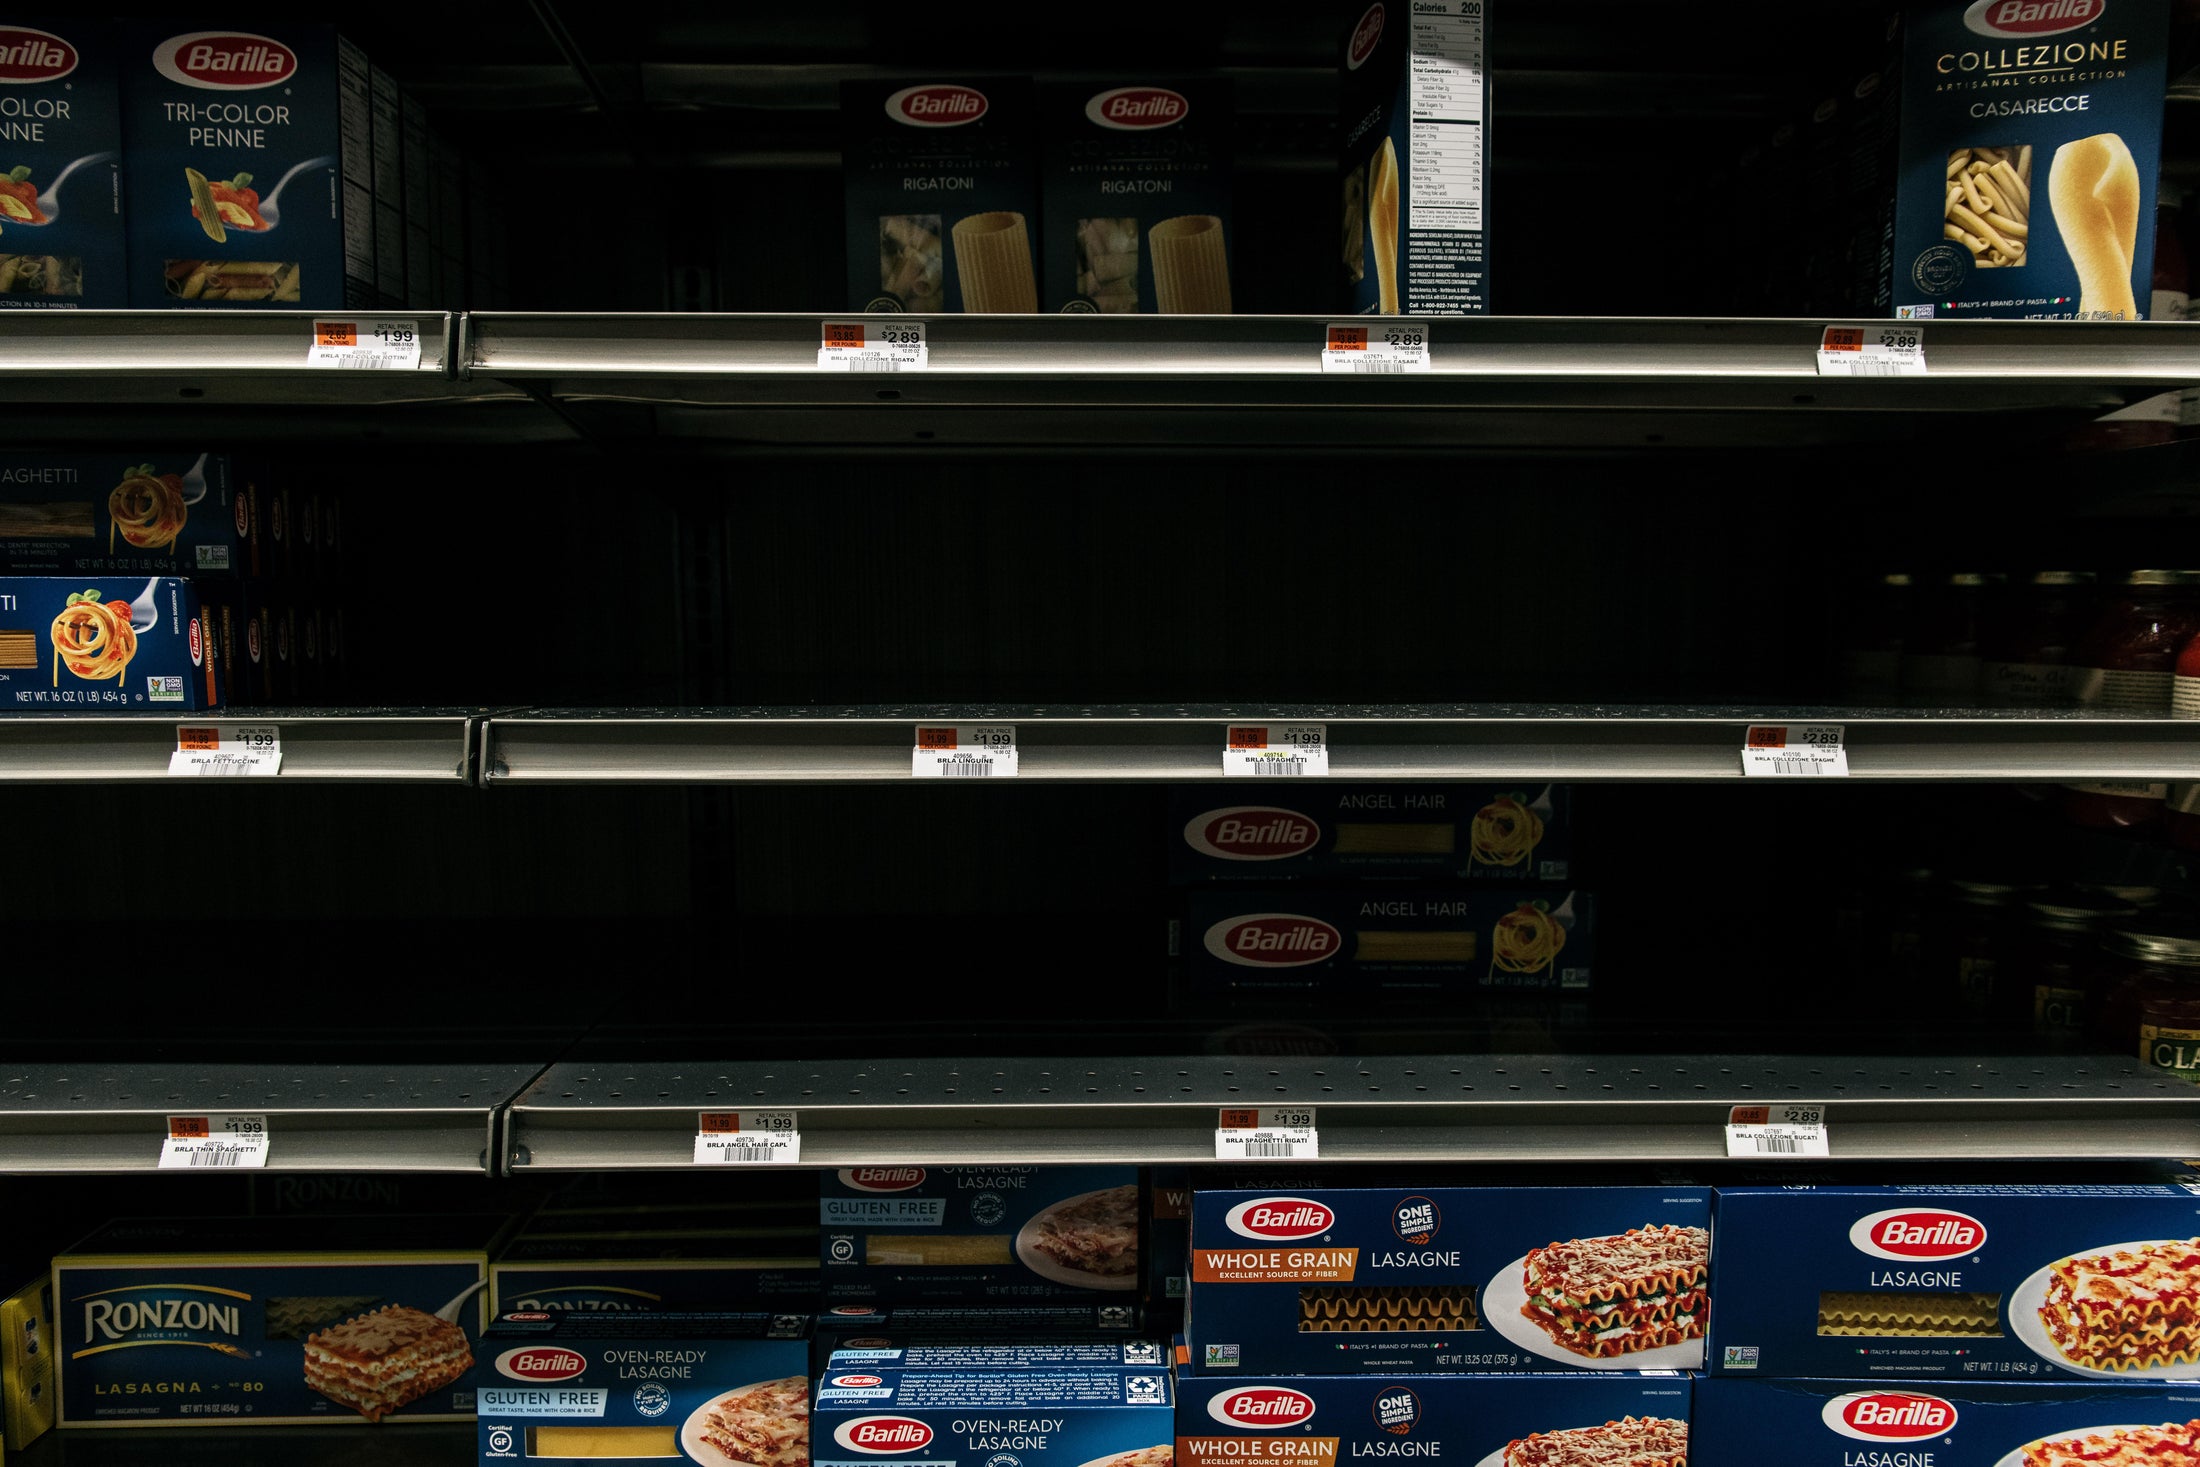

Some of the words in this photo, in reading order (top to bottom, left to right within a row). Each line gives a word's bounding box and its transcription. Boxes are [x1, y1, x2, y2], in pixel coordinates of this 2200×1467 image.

[1413, 2, 1446, 12] Calories
[1462, 2, 1480, 14] 200
[1996, 0, 2093, 24] Barilla
[186, 45, 285, 74] Barilla
[1936, 40, 2128, 74] COLLEZIONE
[1936, 78, 2019, 92] ARTISANAL
[2029, 70, 2127, 85] COLLECTION
[909, 94, 980, 115] Barilla
[1109, 96, 1179, 118] Barilla
[1970, 96, 2089, 119] CASARECCE
[163, 102, 290, 126] TRI-COLOR
[189, 128, 265, 148] PENNE
[904, 178, 974, 190] RIGATONI
[1102, 180, 1172, 193] RIGATONI
[374, 330, 413, 341] $1.99
[882, 331, 919, 343] $2.89
[1385, 334, 1422, 345] $2.89
[1880, 336, 1916, 347] $2.89
[16, 692, 32, 702] NET
[51, 692, 59, 701] 16
[62, 692, 75, 701] OZ
[78, 691, 83, 703] (1
[87, 691, 99, 703] LB)
[103, 691, 119, 701] 454
[122, 694, 127, 704] g
[236, 735, 273, 745] $1.99
[974, 734, 1010, 745] $1.99
[1284, 733, 1320, 744] $1.99
[1803, 733, 1838, 743] $2.89
[1339, 794, 1395, 809] ANGEL
[1404, 794, 1446, 809] HAIR
[1216, 820, 1308, 845] Barilla
[1359, 901, 1418, 917] ANGEL
[1425, 901, 1467, 916] HAIR
[1235, 927, 1329, 951] Barilla
[1274, 1115, 1310, 1124] $1.99
[1785, 1111, 1819, 1121] $2.89
[225, 1123, 262, 1133] $1.99
[756, 1119, 791, 1128] $1.99
[859, 1168, 918, 1182] Barilla
[957, 1177, 1026, 1188] LASAGNE
[828, 1202, 890, 1214] GLUTEN
[900, 1203, 937, 1214] FREE
[1399, 1205, 1432, 1219] ONE
[1251, 1207, 1324, 1227] Barilla
[1401, 1217, 1433, 1228] SIMPLE
[1401, 1225, 1434, 1234] INGREDIENT
[1881, 1221, 1973, 1244] Barilla
[1207, 1253, 1280, 1268] WHOLE
[1288, 1253, 1352, 1268] GRAIN
[1372, 1252, 1461, 1267] LASAGNE
[1871, 1273, 1961, 1287] LASAGNE
[85, 1300, 239, 1343] RONZONI
[517, 1355, 578, 1371] Barilla
[604, 1351, 706, 1363] OVEN-READY
[1437, 1355, 1450, 1365] NET
[1452, 1355, 1463, 1365] WT.
[1465, 1355, 1480, 1365] 13.25
[1482, 1355, 1493, 1365] OZ
[1495, 1354, 1509, 1366] (375
[1511, 1354, 1518, 1366] g)
[619, 1366, 691, 1378] LASAGNE
[1963, 1361, 1976, 1371] NET
[1994, 1361, 1998, 1371] 1
[2000, 1361, 2009, 1371] LB
[2012, 1361, 2028, 1373] (454
[2030, 1362, 2037, 1373] g)
[95, 1382, 201, 1395] LASAGNA
[243, 1382, 264, 1392] 80
[485, 1393, 550, 1404] GLUTEN
[559, 1393, 599, 1404] FREE
[1233, 1396, 1306, 1415] Barilla
[1379, 1394, 1411, 1408] ONE
[1381, 1407, 1413, 1417] SIMPLE
[1382, 1414, 1414, 1424] INGREDIENT
[1854, 1402, 1945, 1426] Barilla
[857, 1425, 924, 1442] Barilla
[952, 1420, 1064, 1434] OVEN-READY
[494, 1438, 508, 1446] GF
[969, 1436, 1047, 1450] LASAGNE
[1189, 1441, 1262, 1456] WHOLE
[1269, 1441, 1333, 1455] GRAIN
[1353, 1442, 1440, 1456] LASAGNE
[1845, 1452, 1934, 1467] LASAGNE
